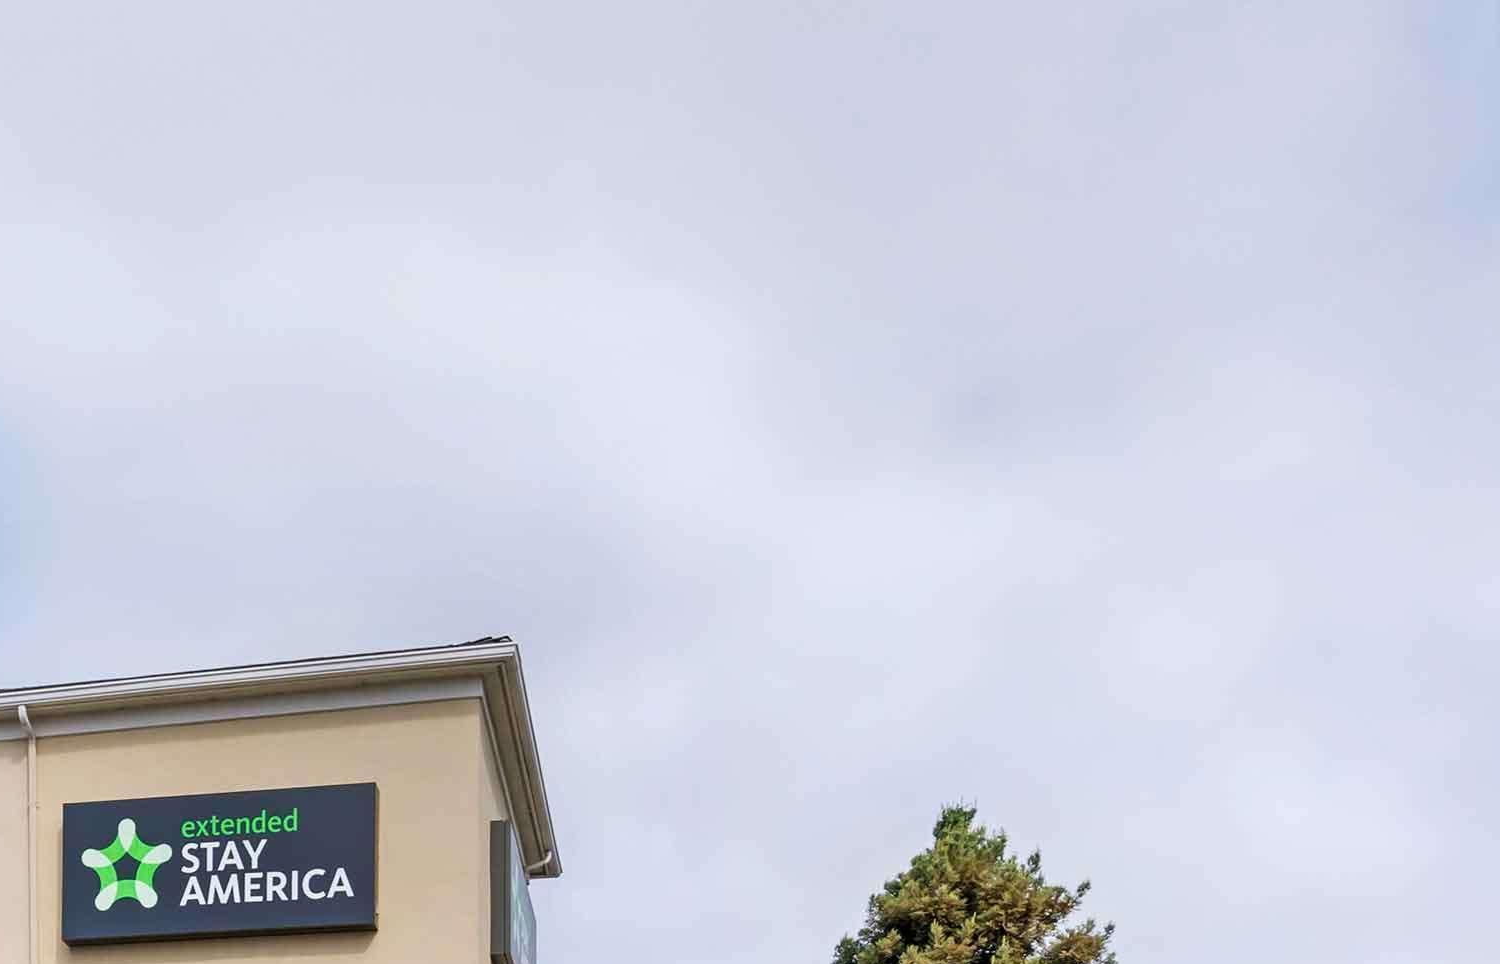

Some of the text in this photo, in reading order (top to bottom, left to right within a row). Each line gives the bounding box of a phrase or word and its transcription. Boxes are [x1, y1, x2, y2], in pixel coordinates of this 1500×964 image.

[180, 807, 299, 838] extended
[180, 838, 268, 874] STAY
[179, 867, 354, 907] AMERICA
